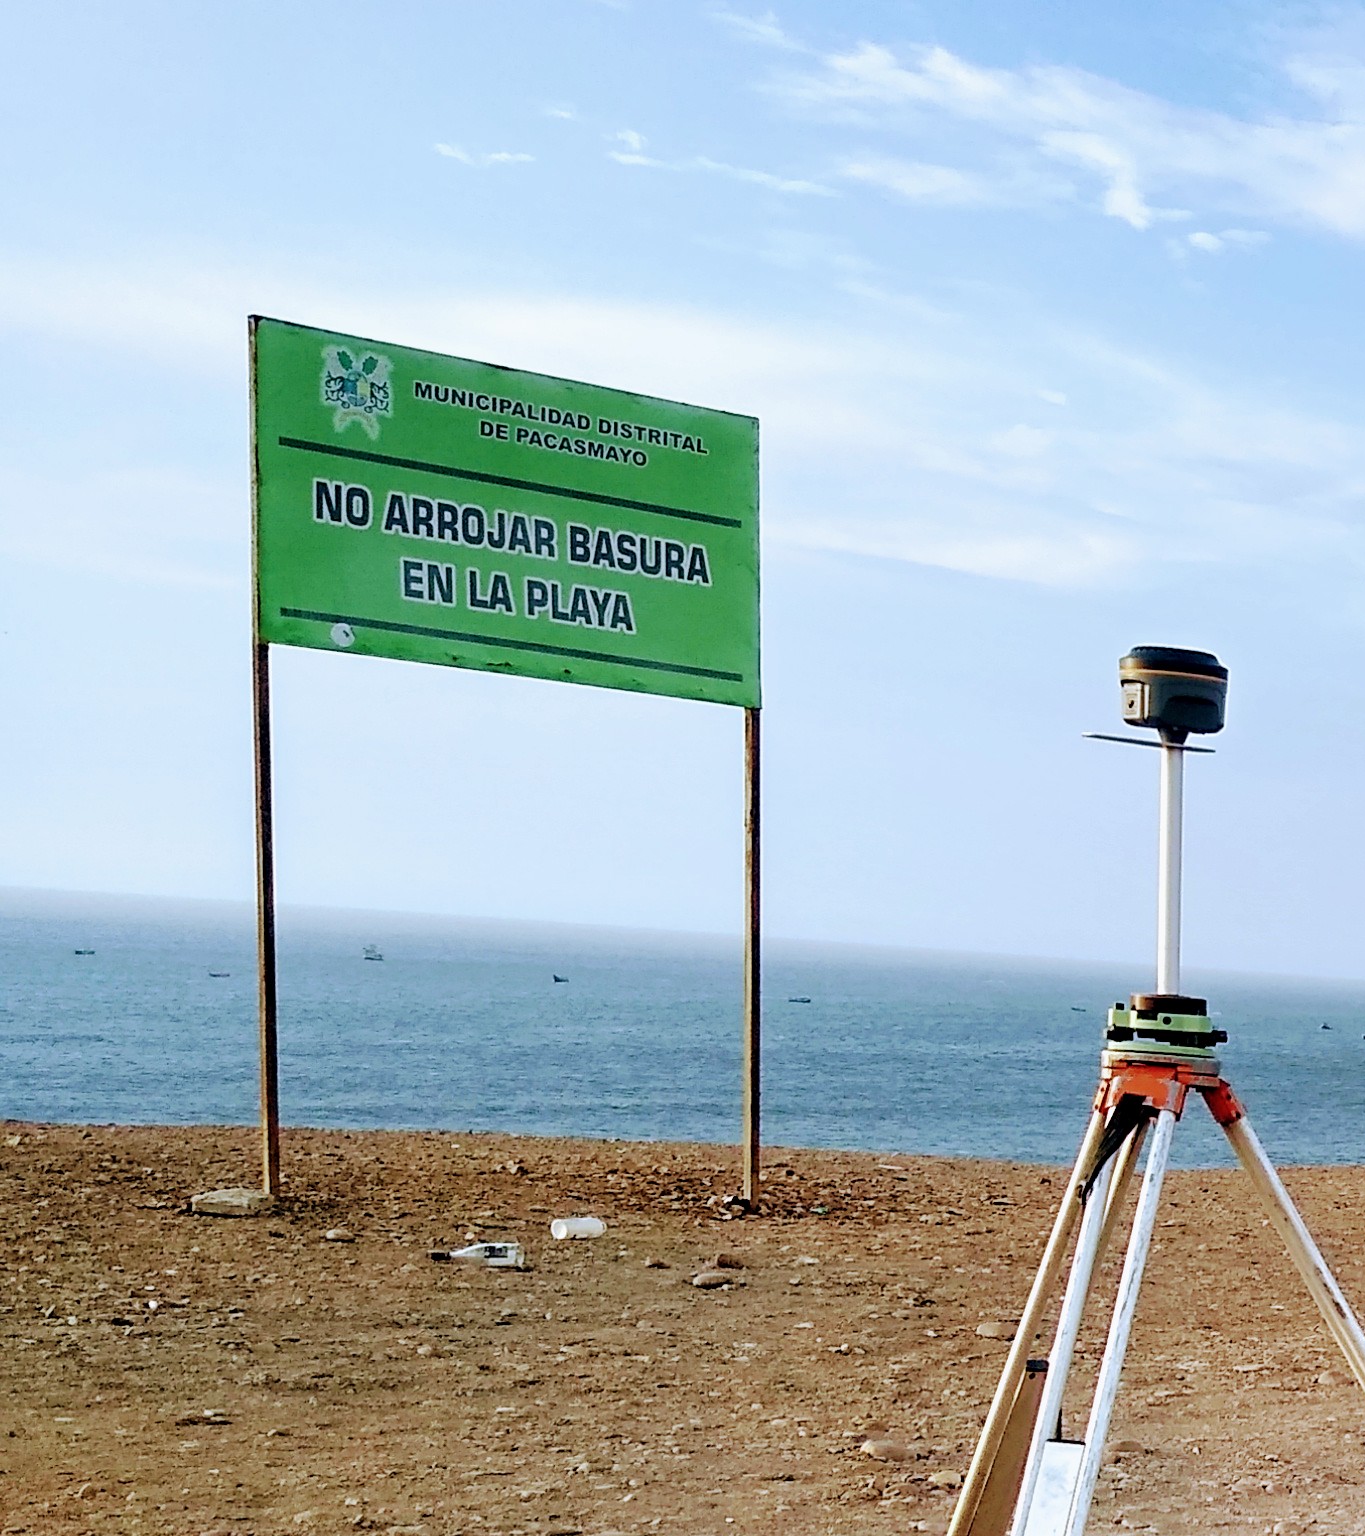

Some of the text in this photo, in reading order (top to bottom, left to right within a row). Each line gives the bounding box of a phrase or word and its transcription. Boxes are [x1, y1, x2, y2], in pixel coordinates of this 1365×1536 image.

[414, 381, 709, 455] MUNICIPALIDAD DISTRITAL
[480, 420, 648, 467] DE PACASMAYO
[315, 481, 711, 585] NO ARROJAR BASURA
[402, 559, 634, 632] EN LA PLAYA
